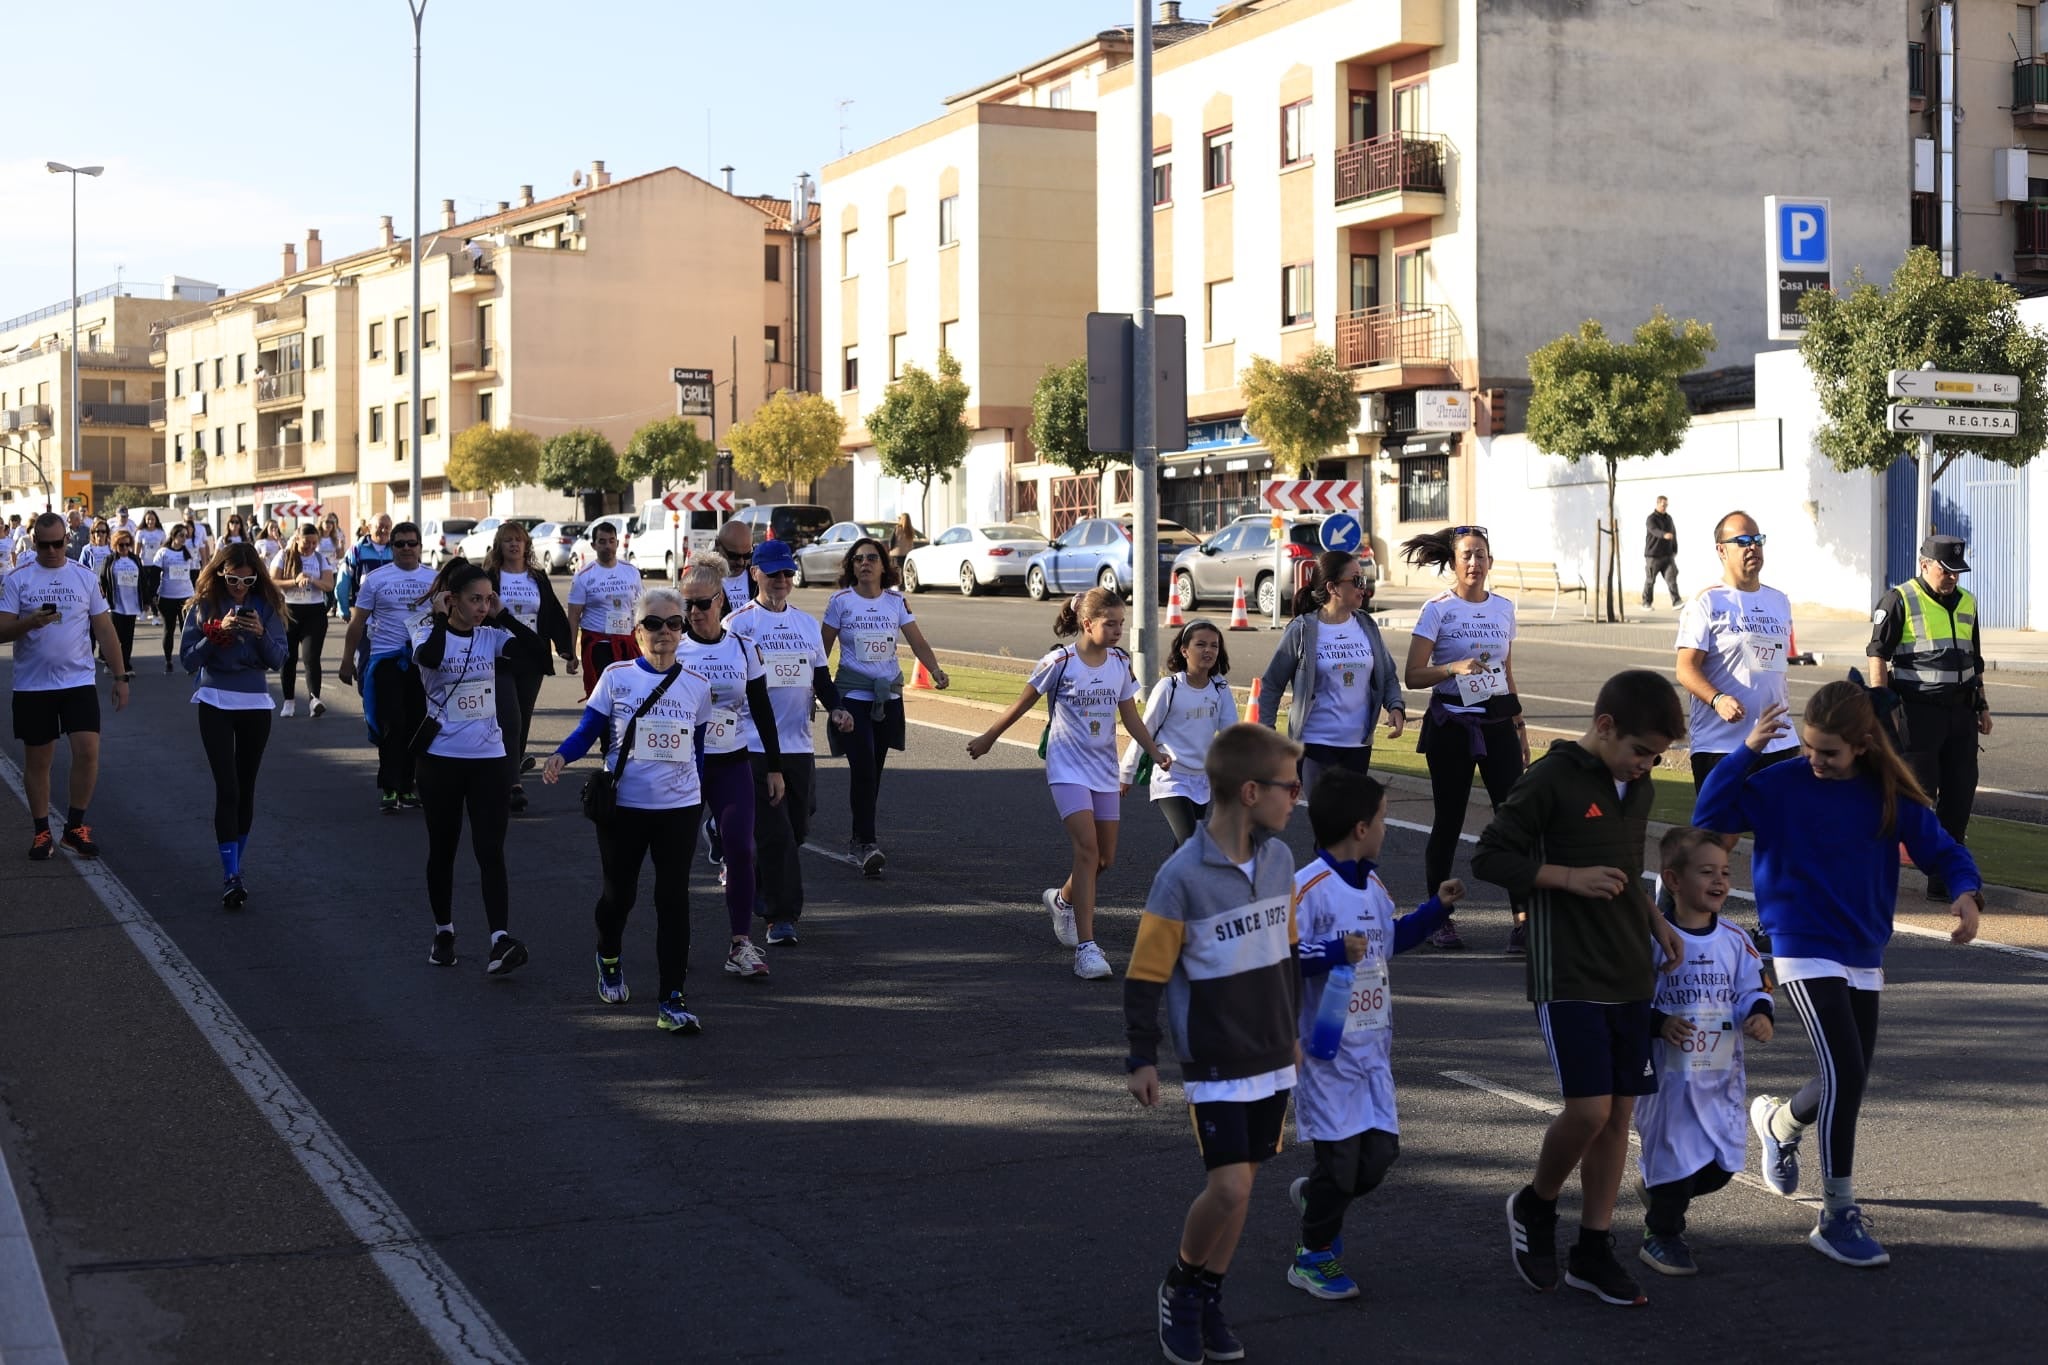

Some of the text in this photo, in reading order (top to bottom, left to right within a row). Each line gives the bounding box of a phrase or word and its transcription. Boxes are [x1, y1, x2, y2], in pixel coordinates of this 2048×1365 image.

[1791, 211, 1818, 257] P
[1780, 278, 1803, 292] Casa
[675, 370, 694, 379] Casa
[682, 385, 711, 402] GRILL
[1948, 415, 2015, 429] R.E.G.T.S.A.
[48, 587, 75, 595] CARRERA
[863, 641, 887, 653] 766
[1752, 645, 1776, 661] 727
[774, 664, 801, 677] 652
[1469, 674, 1499, 693] 812
[457, 694, 485, 710] 651
[647, 732, 681, 749] 839
[1215, 905, 1287, 942] SINCE 1975
[1666, 974, 1680, 988] III
[1348, 987, 1383, 1014] 686
[1680, 1030, 1722, 1053] 687
